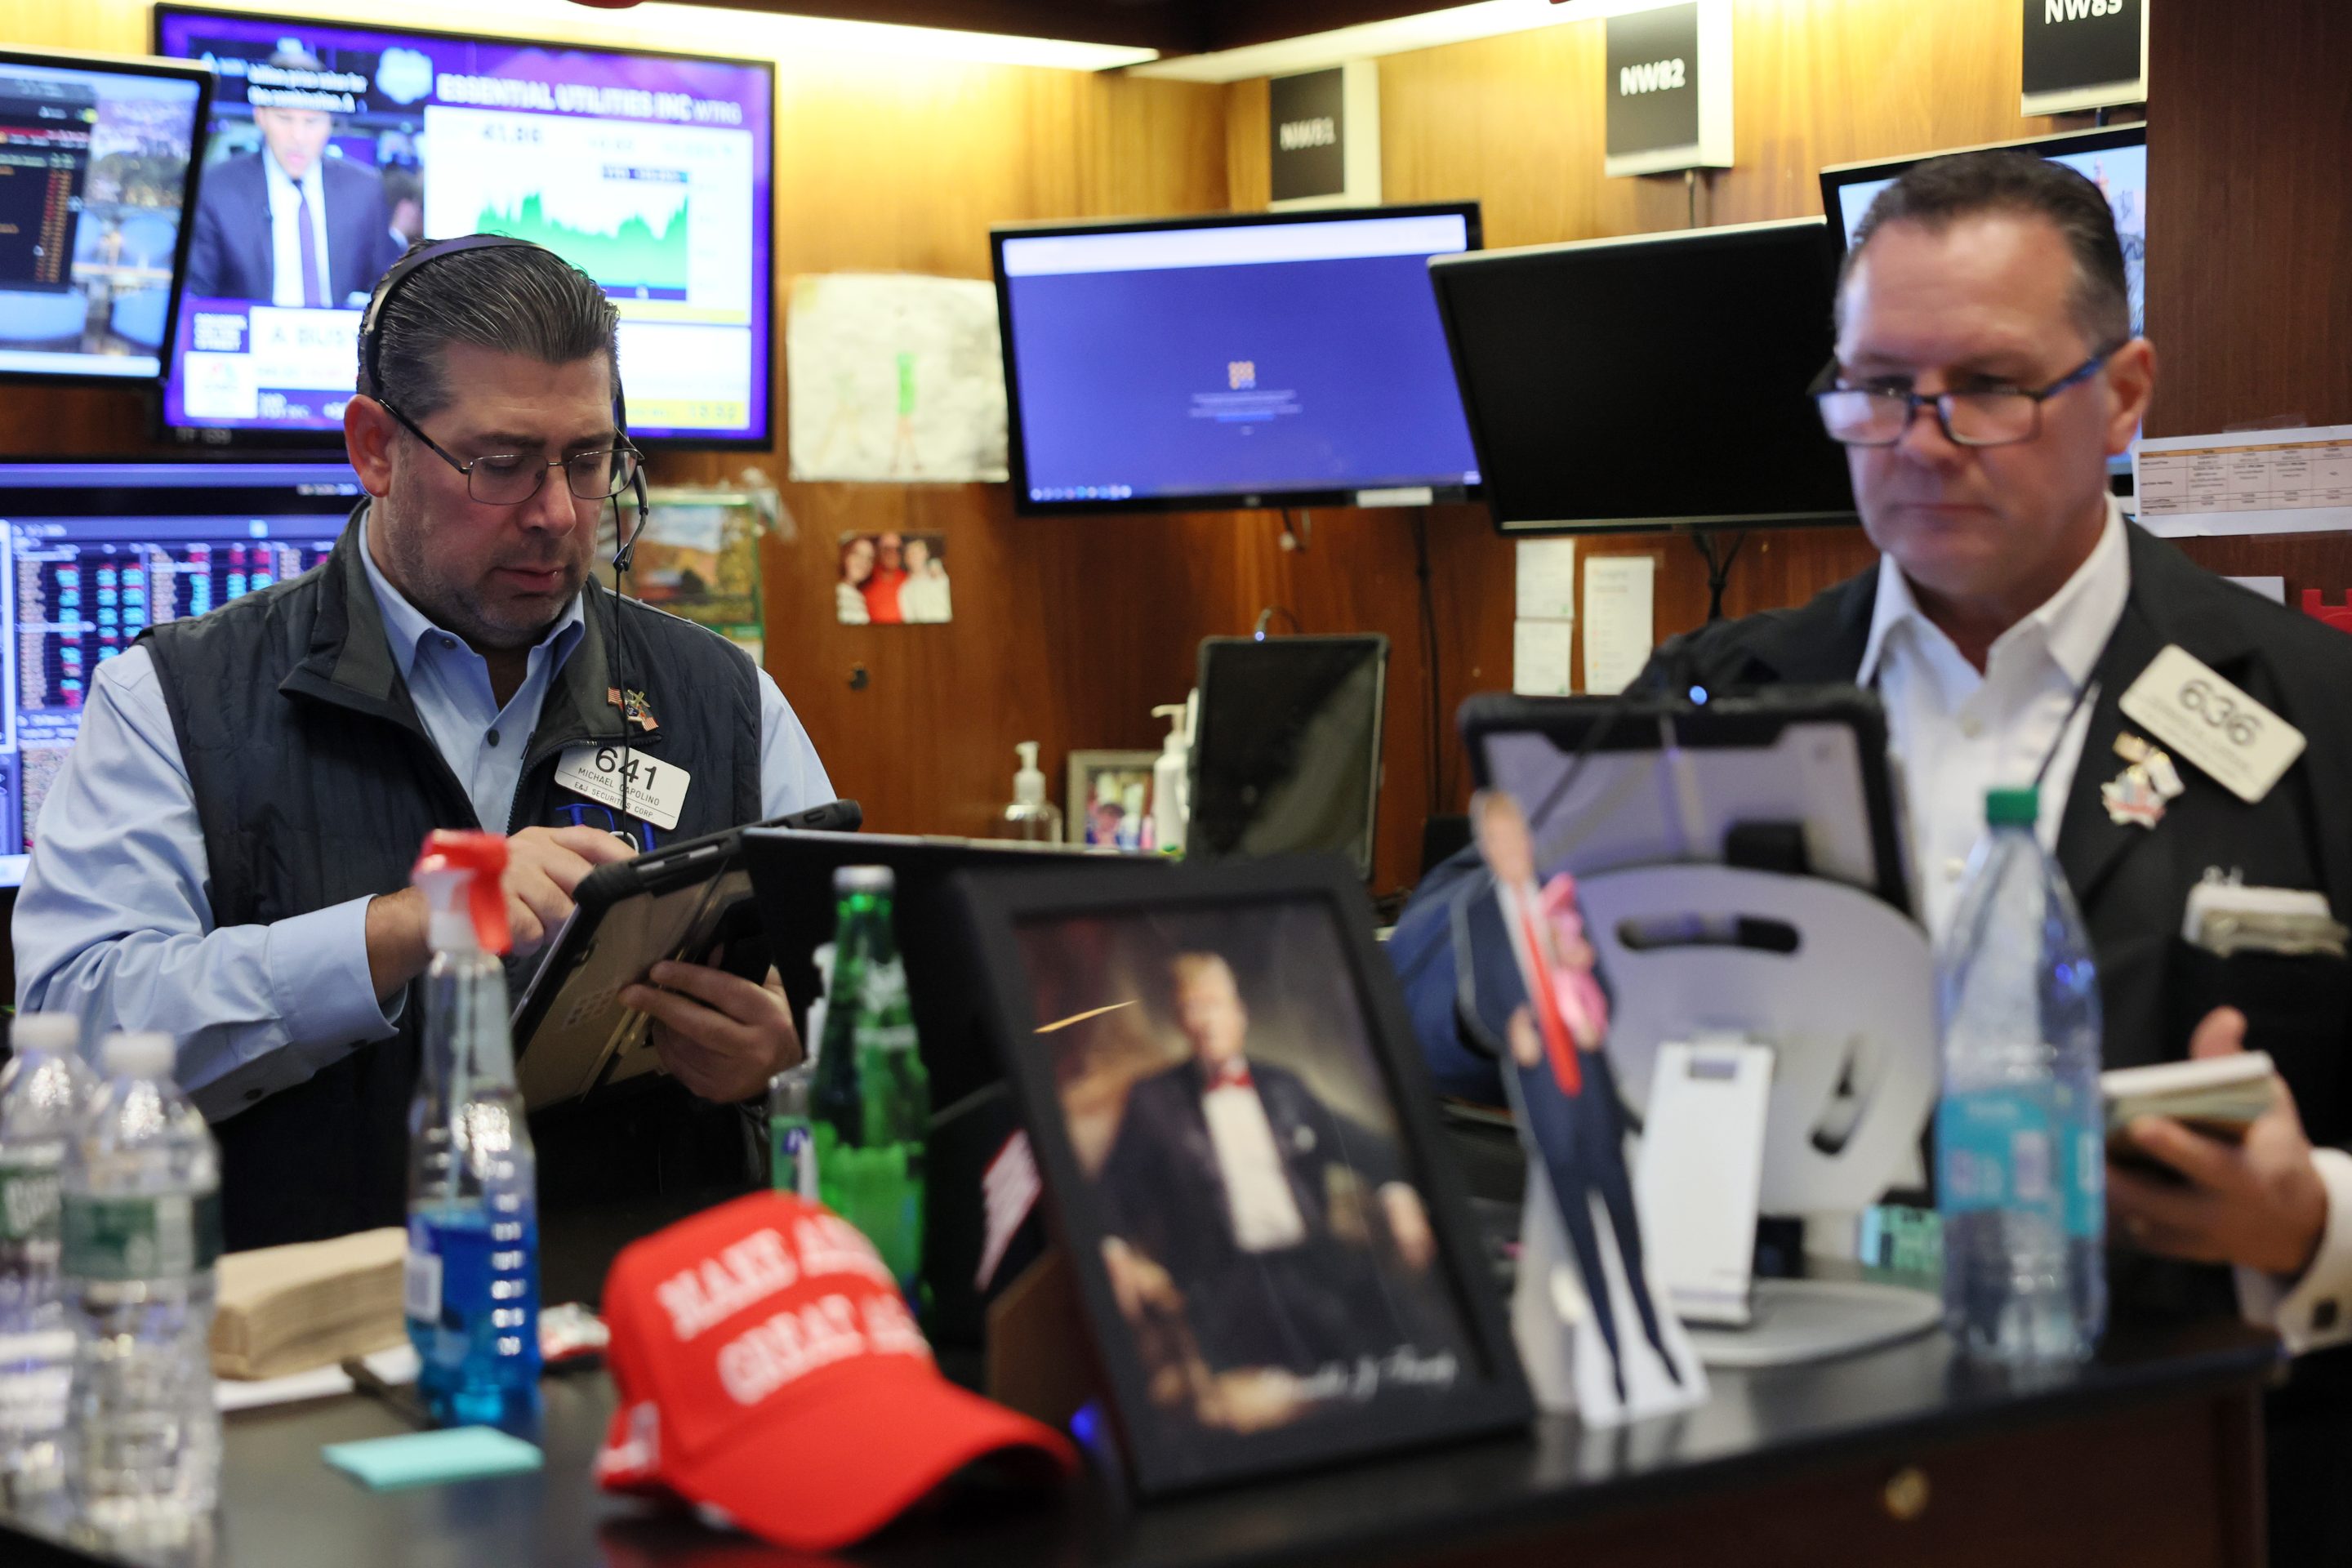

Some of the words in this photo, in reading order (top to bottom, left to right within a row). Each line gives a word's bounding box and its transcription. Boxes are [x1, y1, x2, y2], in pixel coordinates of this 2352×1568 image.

[436, 73, 555, 110] ESSENTIAL
[555, 83, 653, 118] UTILITIES
[654, 92, 693, 122] INC
[1620, 58, 1686, 96] NW82
[2178, 678, 2265, 746] 636
[578, 768, 614, 788] MICHAEL
[619, 784, 660, 806] CAPOLINO
[595, 746, 657, 791] 641
[574, 782, 589, 792] E&J
[591, 788, 631, 809] SECURITIS
